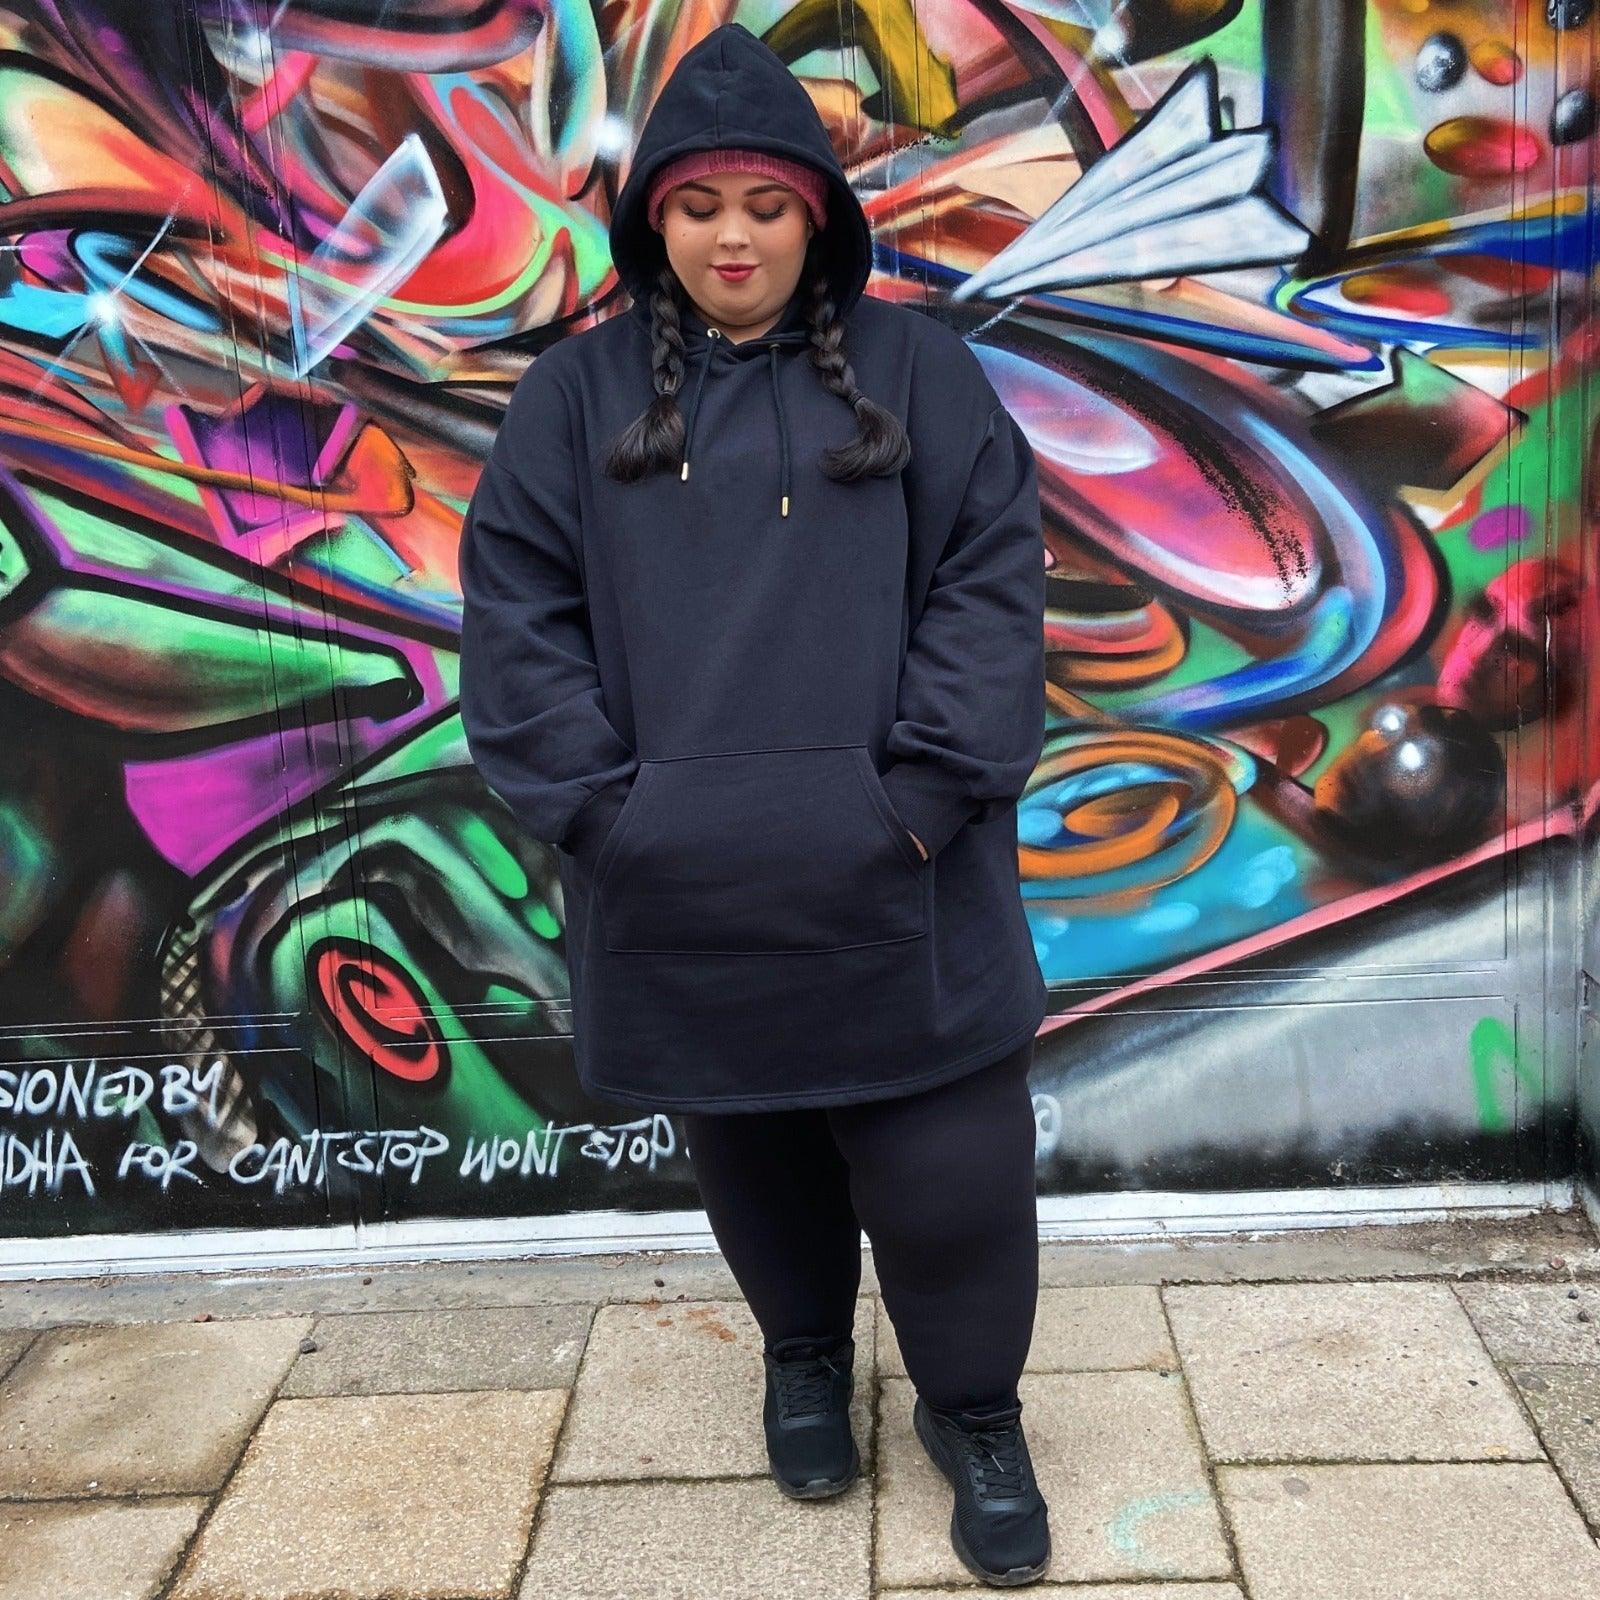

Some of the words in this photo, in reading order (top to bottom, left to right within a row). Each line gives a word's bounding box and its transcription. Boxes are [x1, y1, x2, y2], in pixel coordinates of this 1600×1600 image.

[159, 1060, 225, 1128] BY
[117, 1138, 203, 1193] FOR
[337, 1126, 449, 1184] STOP
[580, 1114, 676, 1171] STOP
